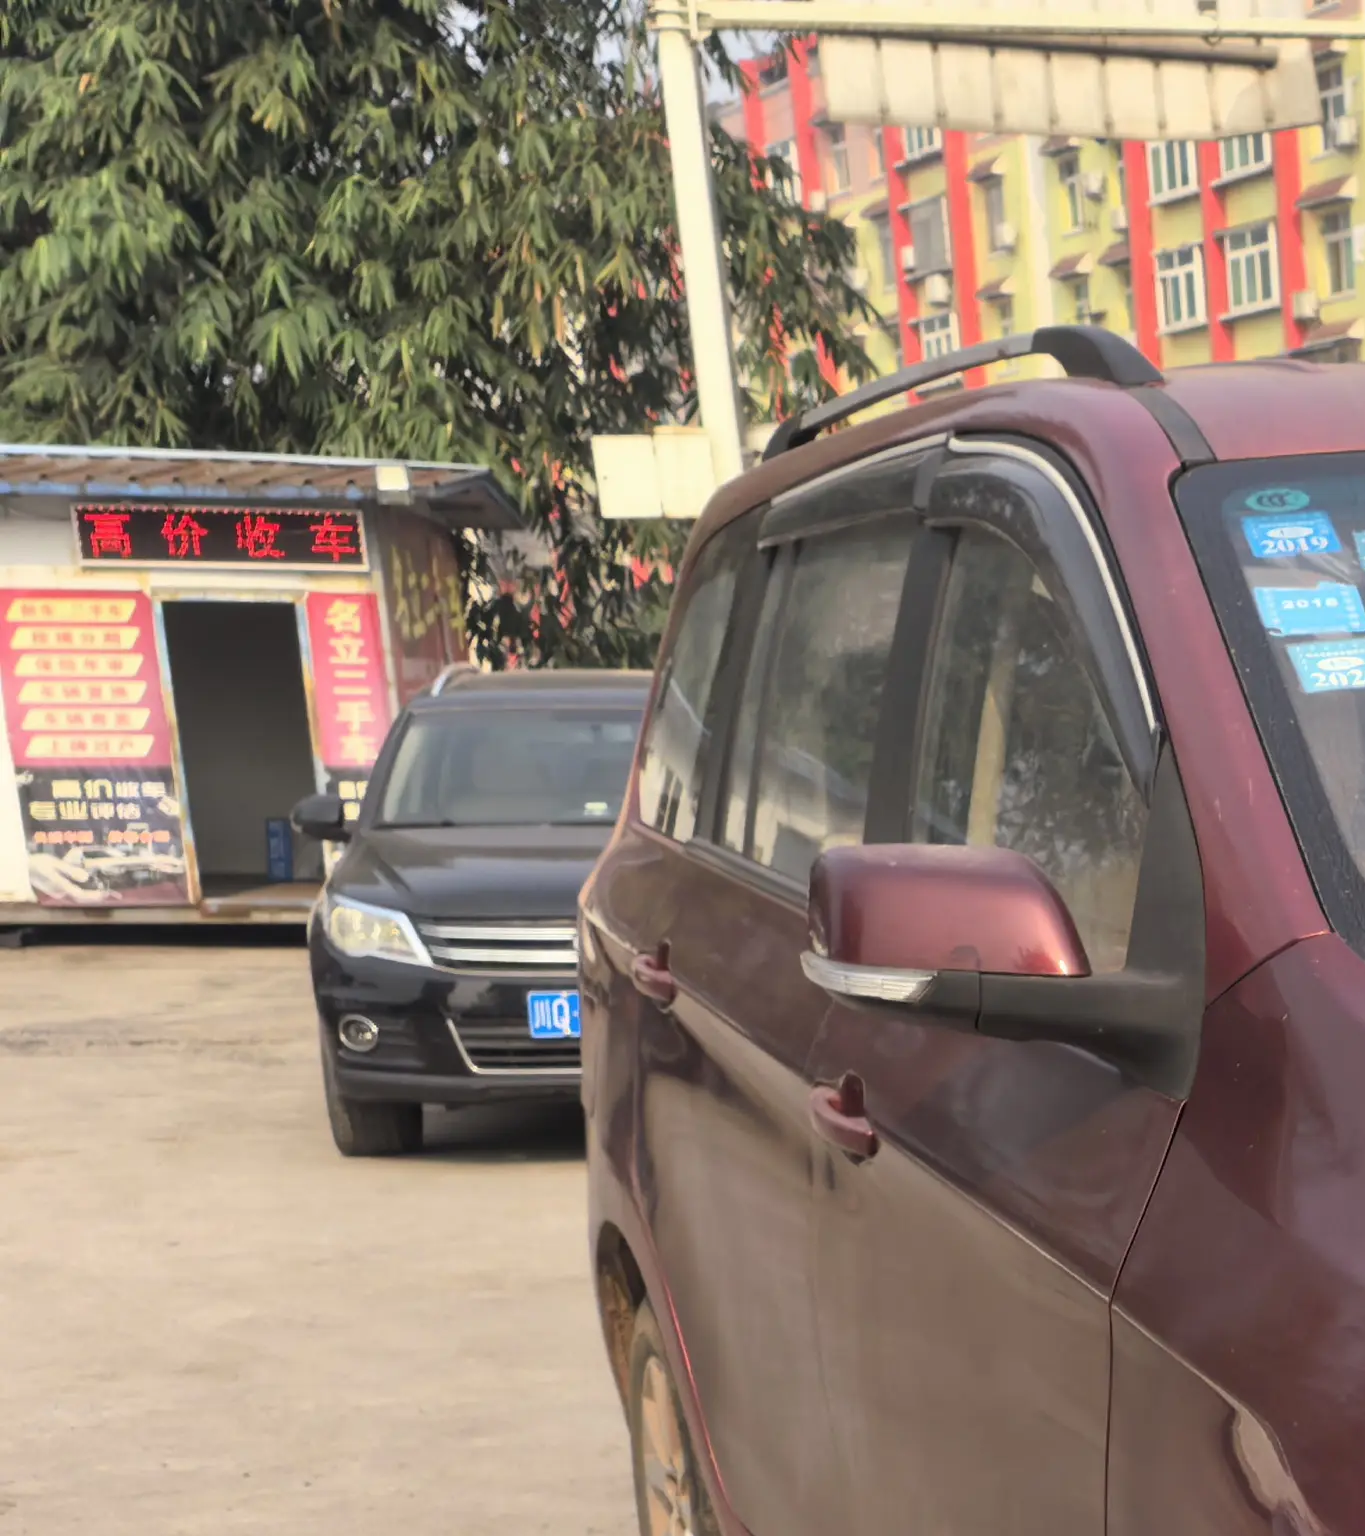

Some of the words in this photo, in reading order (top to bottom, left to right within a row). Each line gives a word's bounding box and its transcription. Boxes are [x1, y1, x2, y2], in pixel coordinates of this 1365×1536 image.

[84, 510, 357, 562] 高价收车
[1260, 536, 1329, 555] 2019
[325, 599, 379, 764] 名立二手车
